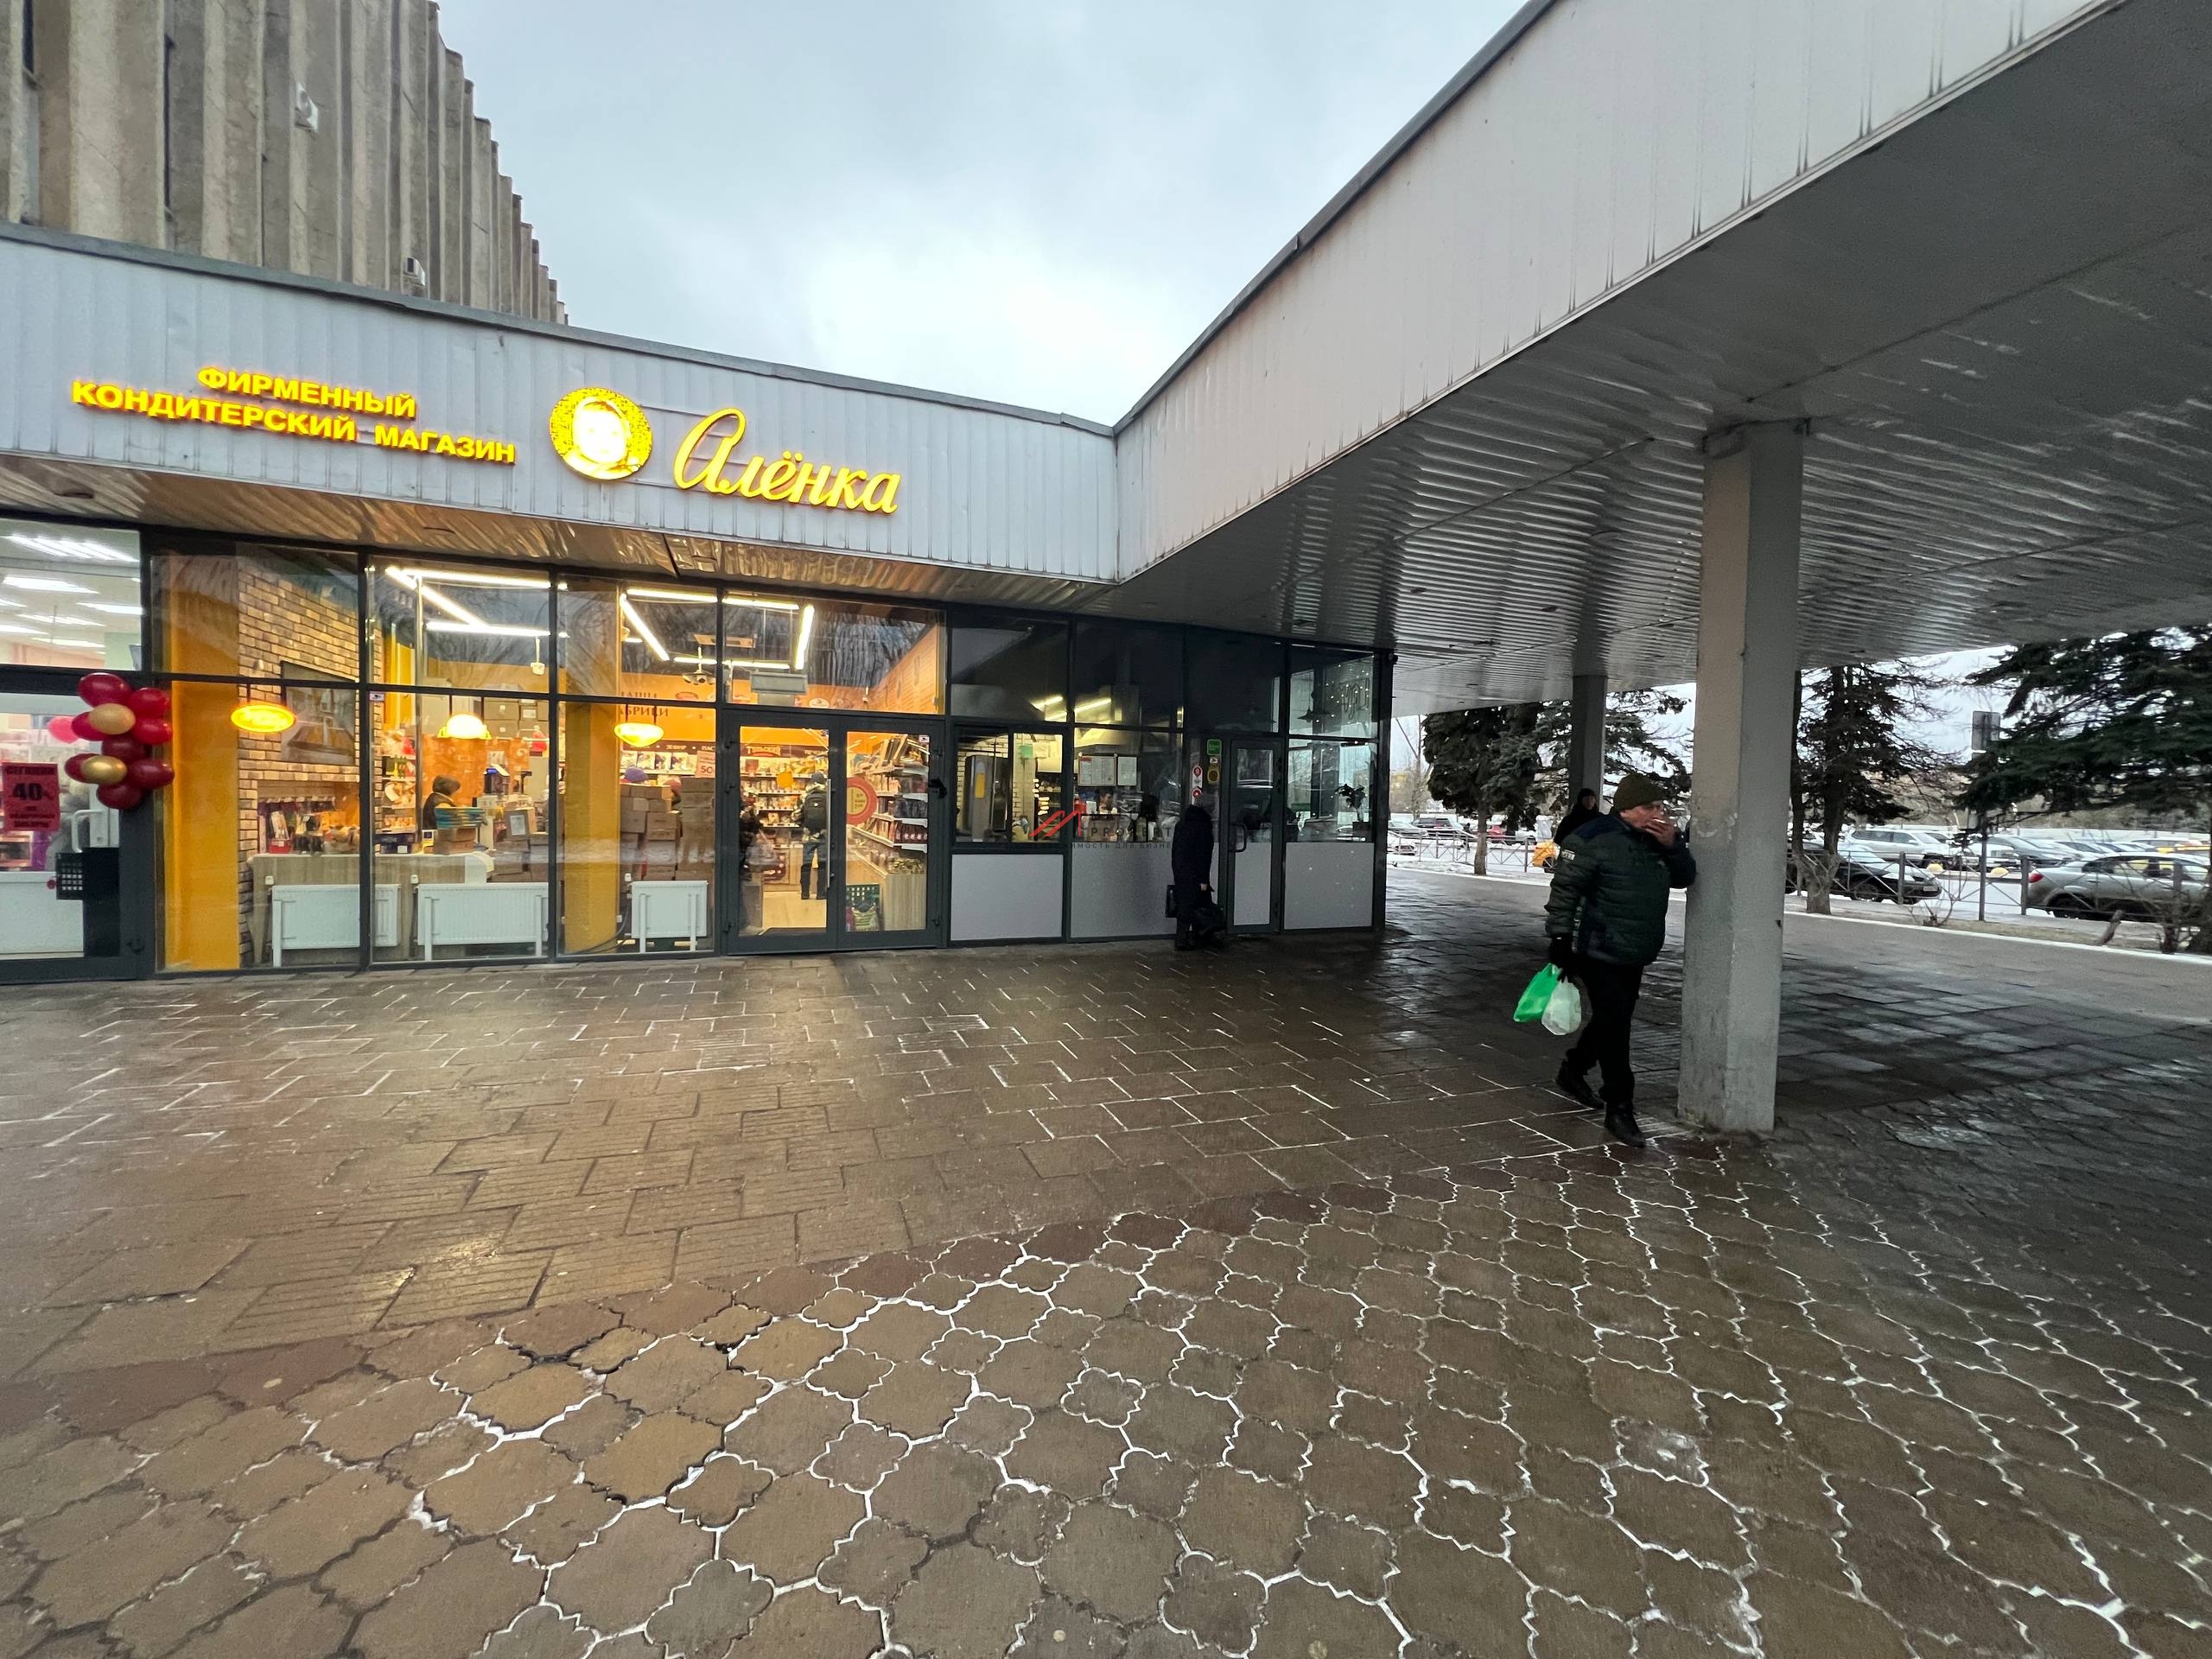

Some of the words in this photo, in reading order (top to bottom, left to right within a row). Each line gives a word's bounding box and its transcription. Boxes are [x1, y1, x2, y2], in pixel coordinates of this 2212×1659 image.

[71, 380, 357, 442] КОНДИТЕРСКИЙ
[374, 423, 517, 464] МАГАЗИН
[197, 365, 416, 419] ФИРМЕННЫЙ
[674, 407, 902, 515] Алёнка
